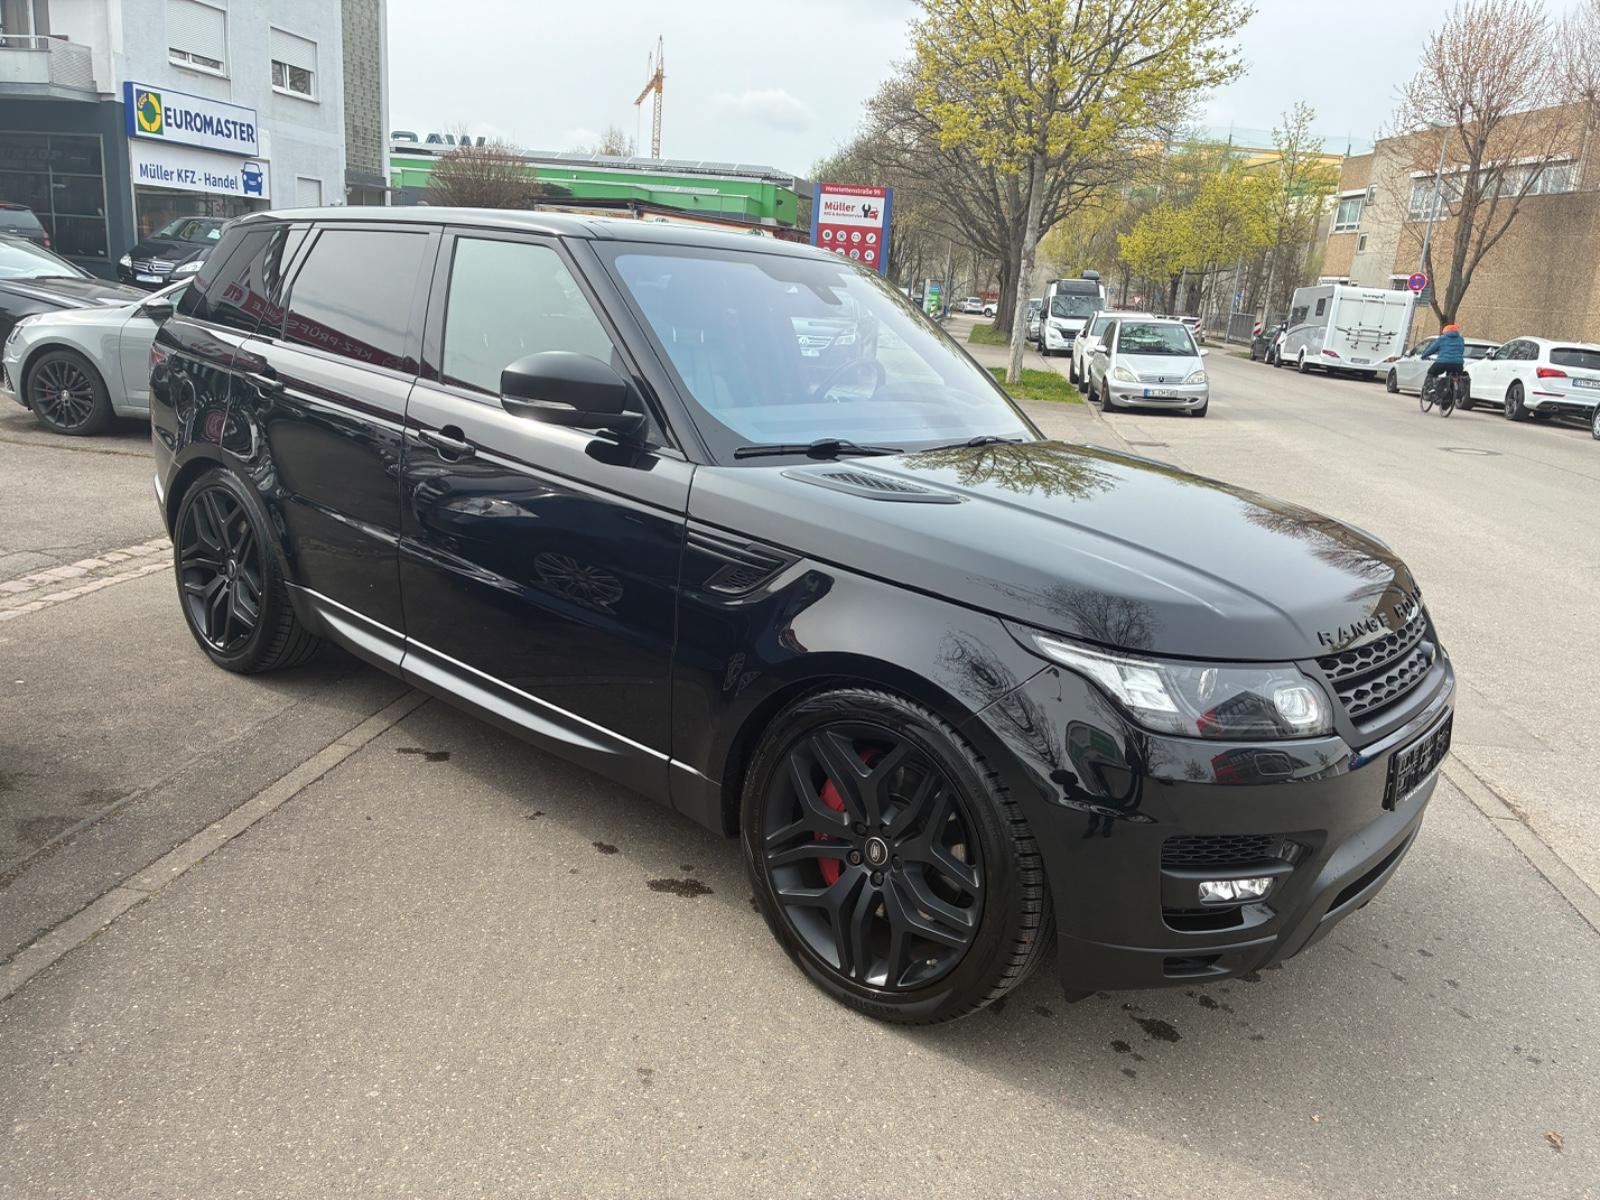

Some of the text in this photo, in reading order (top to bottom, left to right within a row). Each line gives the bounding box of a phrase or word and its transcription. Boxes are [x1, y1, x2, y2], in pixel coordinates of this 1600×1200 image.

[164, 106, 255, 143] EUROMASTER
[139, 162, 175, 182] Müller
[176, 168, 197, 185] KFZ
[203, 172, 239, 191] Handel
[824, 201, 856, 212] Müller
[1317, 612, 1390, 646] RANGE
